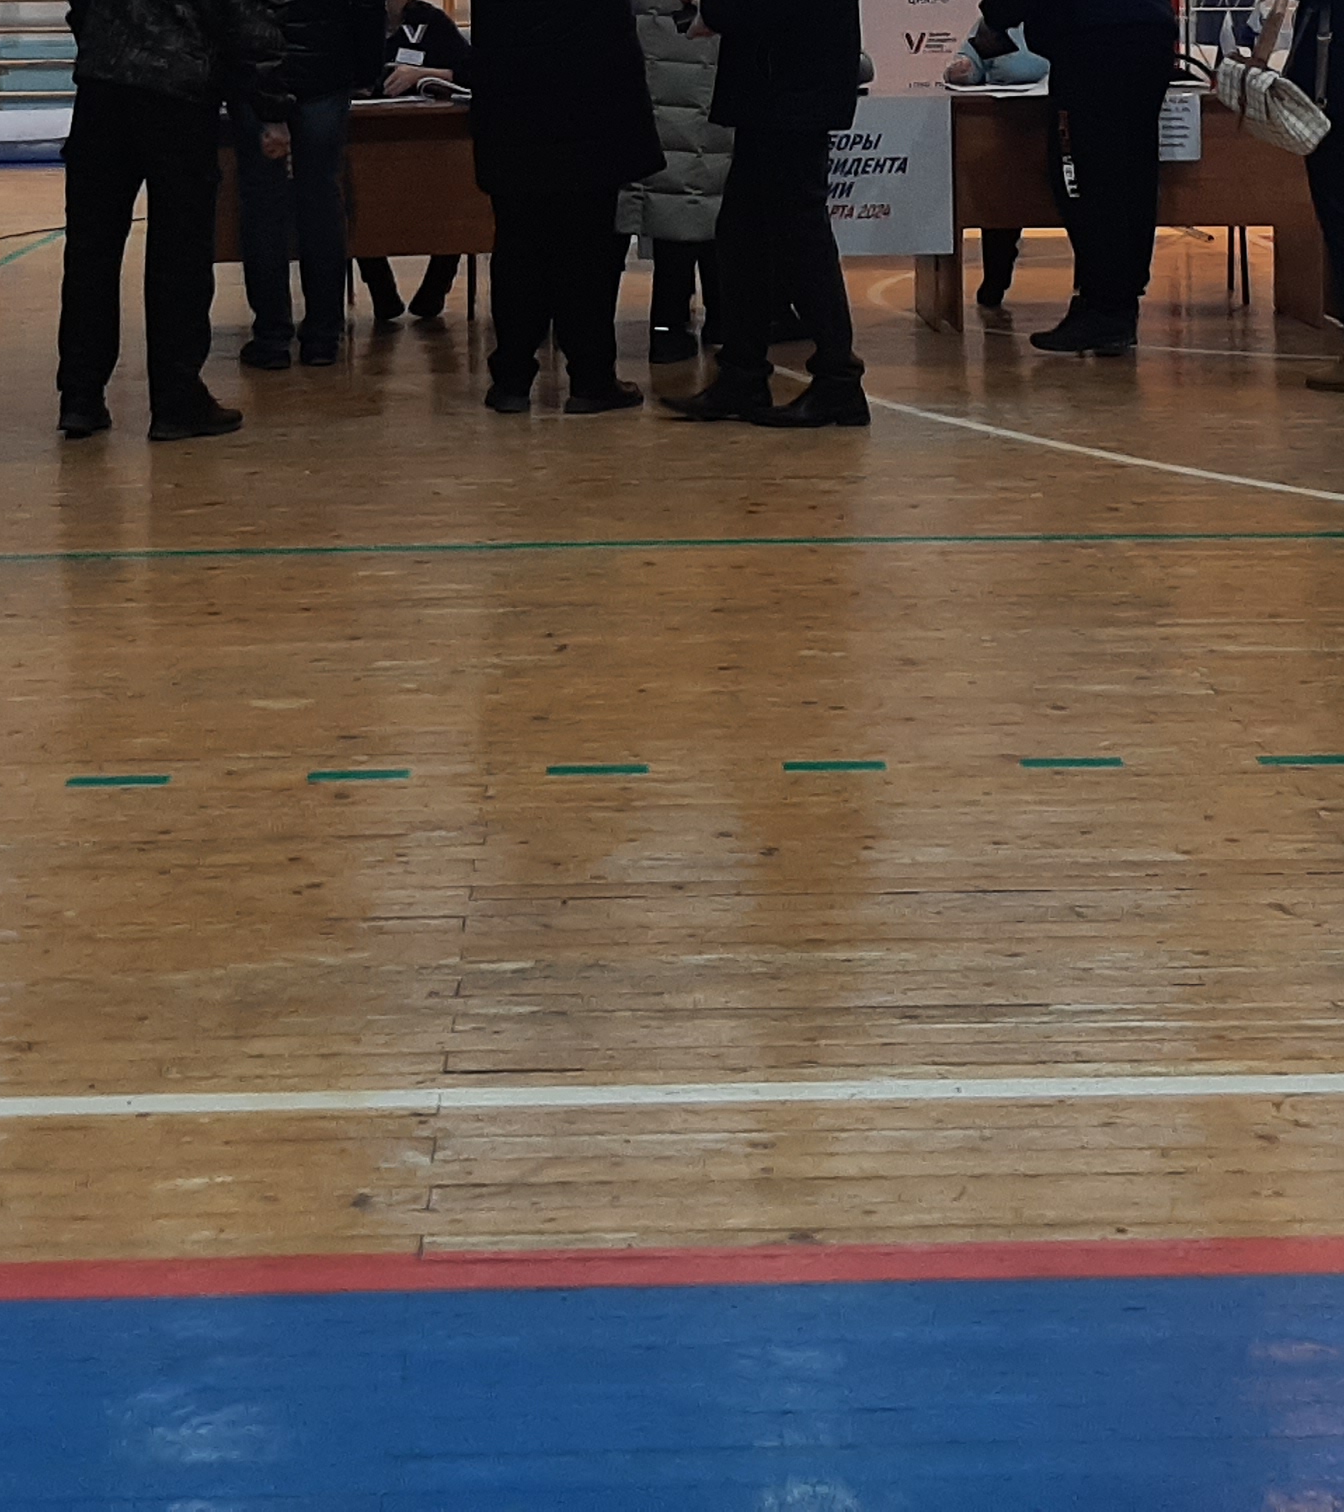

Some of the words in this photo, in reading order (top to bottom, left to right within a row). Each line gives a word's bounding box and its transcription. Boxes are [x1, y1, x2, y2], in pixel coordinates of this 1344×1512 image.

[827, 133, 882, 152] БОРЫ
[827, 157, 909, 178] ЗИДЕНТА
[829, 204, 855, 219] РТА
[857, 204, 891, 219] 2024
